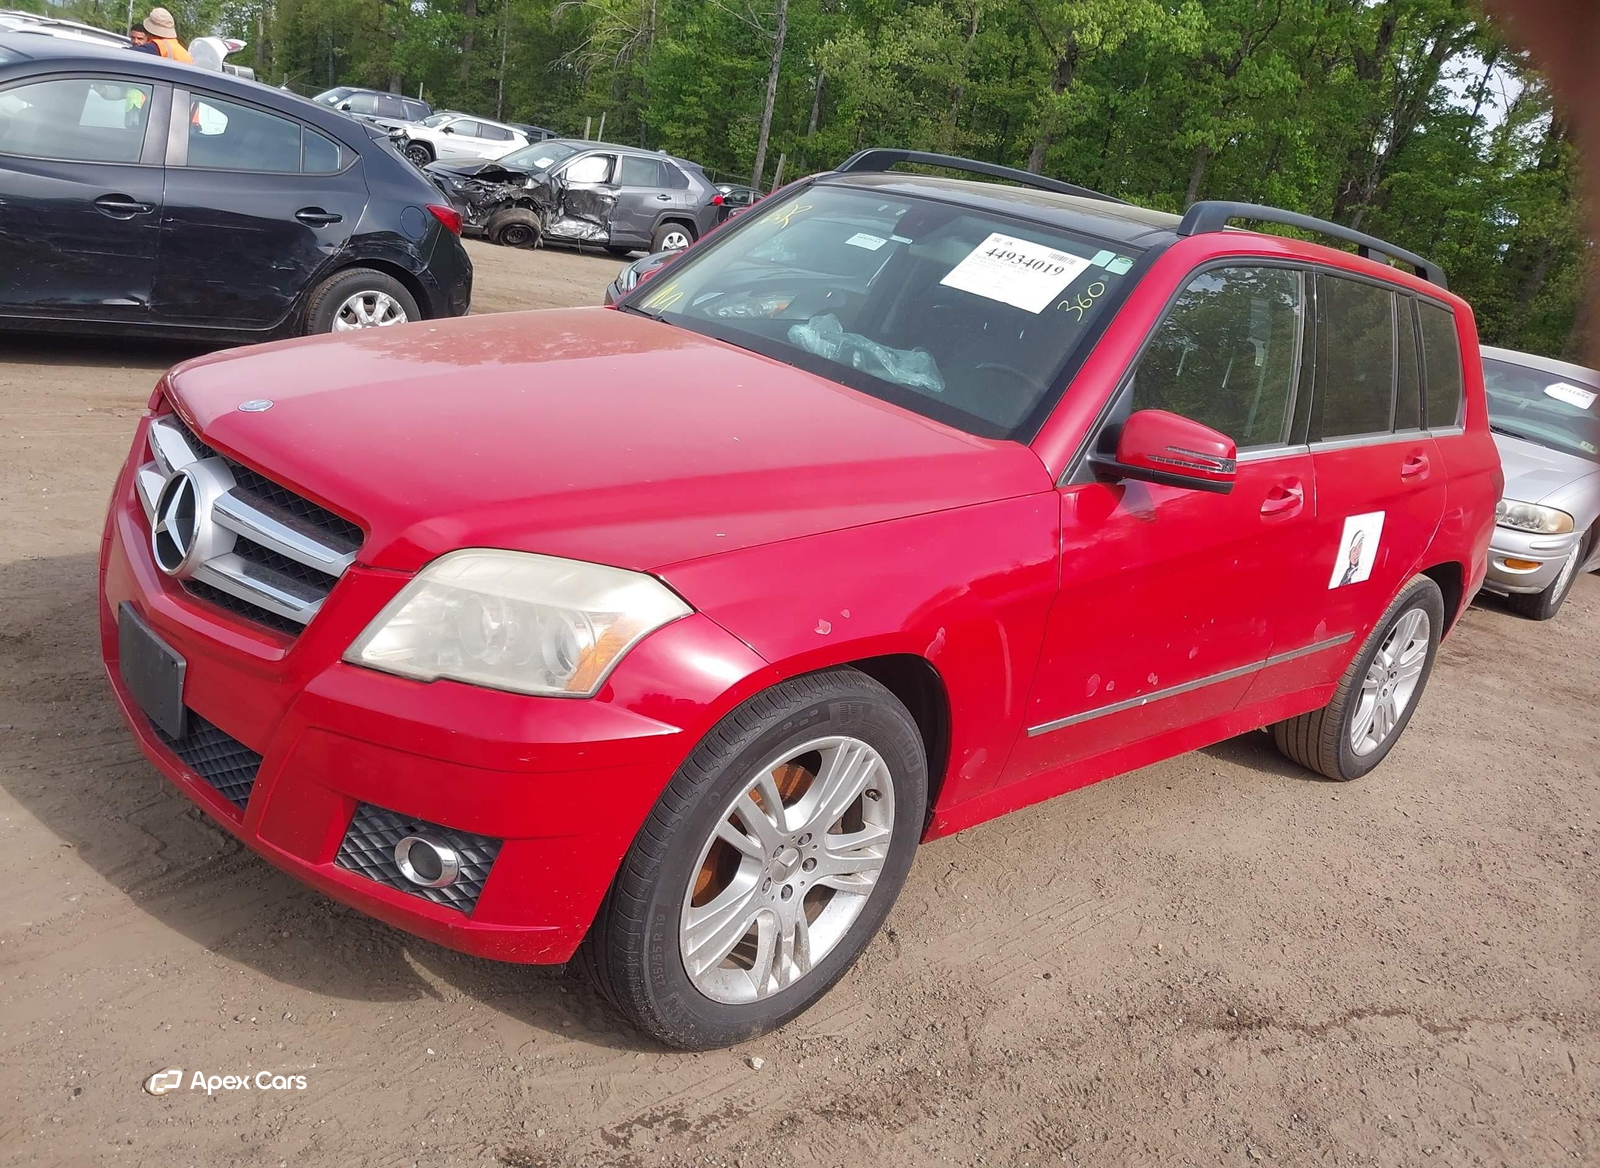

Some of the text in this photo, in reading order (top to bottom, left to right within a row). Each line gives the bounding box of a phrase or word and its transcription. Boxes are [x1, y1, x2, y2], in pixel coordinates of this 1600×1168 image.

[985, 248, 1065, 276] 44934019
[1057, 282, 1105, 322] 360
[914, 778, 923, 830] PRIMACY
[656, 913, 666, 927] 19
[653, 931, 663, 944] R
